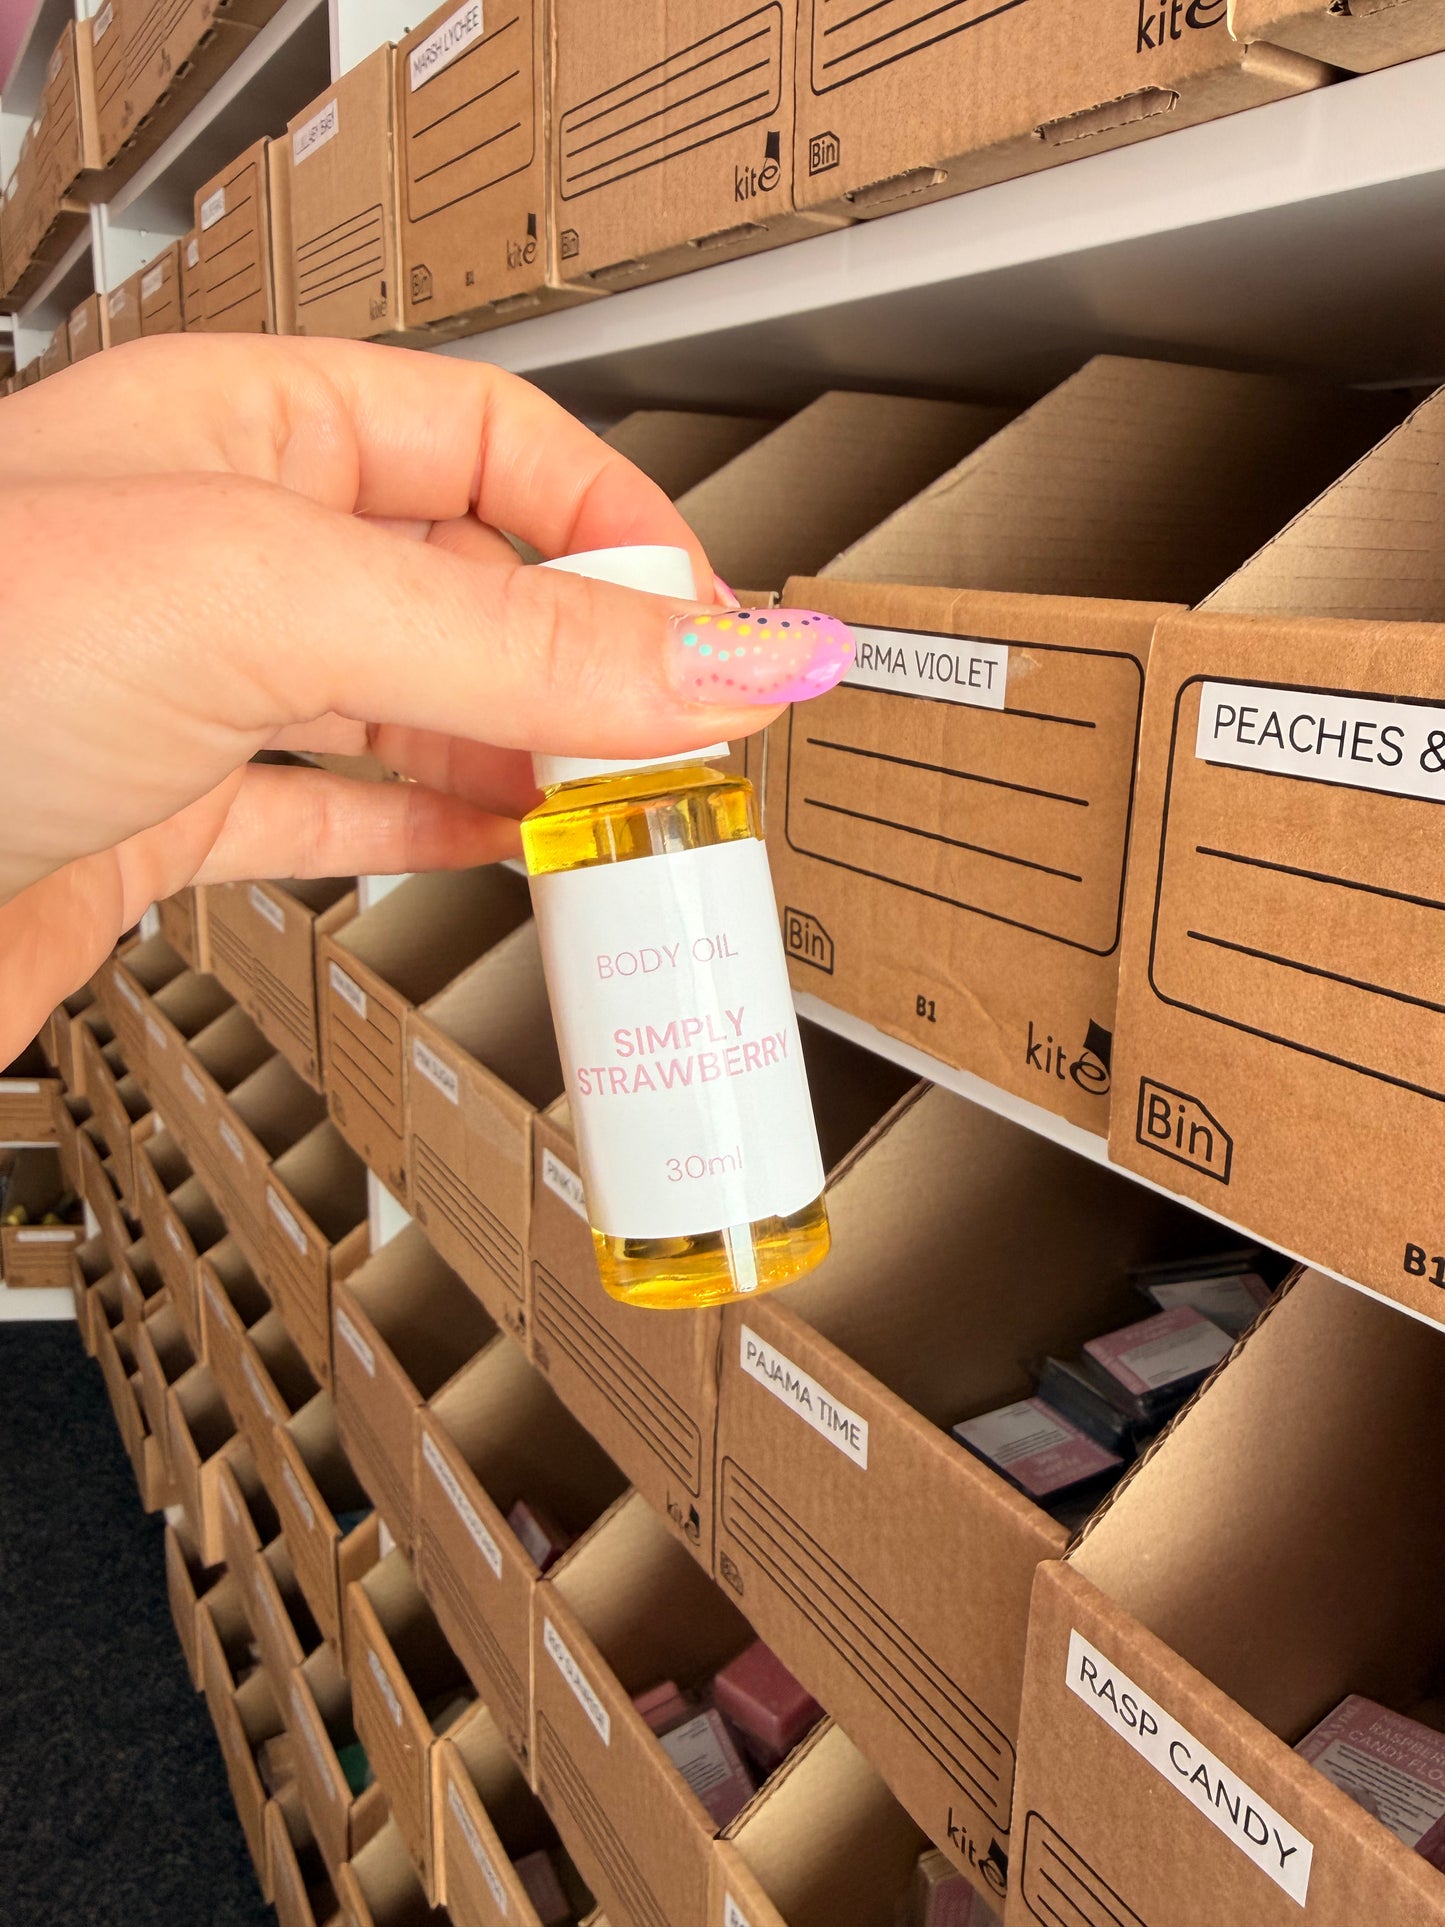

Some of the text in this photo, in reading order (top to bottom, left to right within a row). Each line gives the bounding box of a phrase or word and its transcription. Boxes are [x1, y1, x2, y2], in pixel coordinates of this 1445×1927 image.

[811, 139, 836, 169] Bin
[734, 159, 781, 203] kite
[915, 650, 998, 690] VIOLET
[1213, 703, 1406, 767] PEACHES
[597, 933, 739, 980] BODY OIL
[789, 916, 825, 961] Bin
[613, 1006, 745, 1058] SIMPLY
[916, 994, 936, 1023] B1
[577, 1028, 788, 1096] STRAWBERRY
[1025, 1020, 1112, 1096] kite
[1147, 1092, 1213, 1162] Bin
[665, 1145, 742, 1182] 30ml
[1403, 1242, 1445, 1289] B1
[747, 1340, 861, 1451] PAJAMA TIME
[1079, 1655, 1158, 1736] RASP
[1169, 1740, 1298, 1868] CANDY
